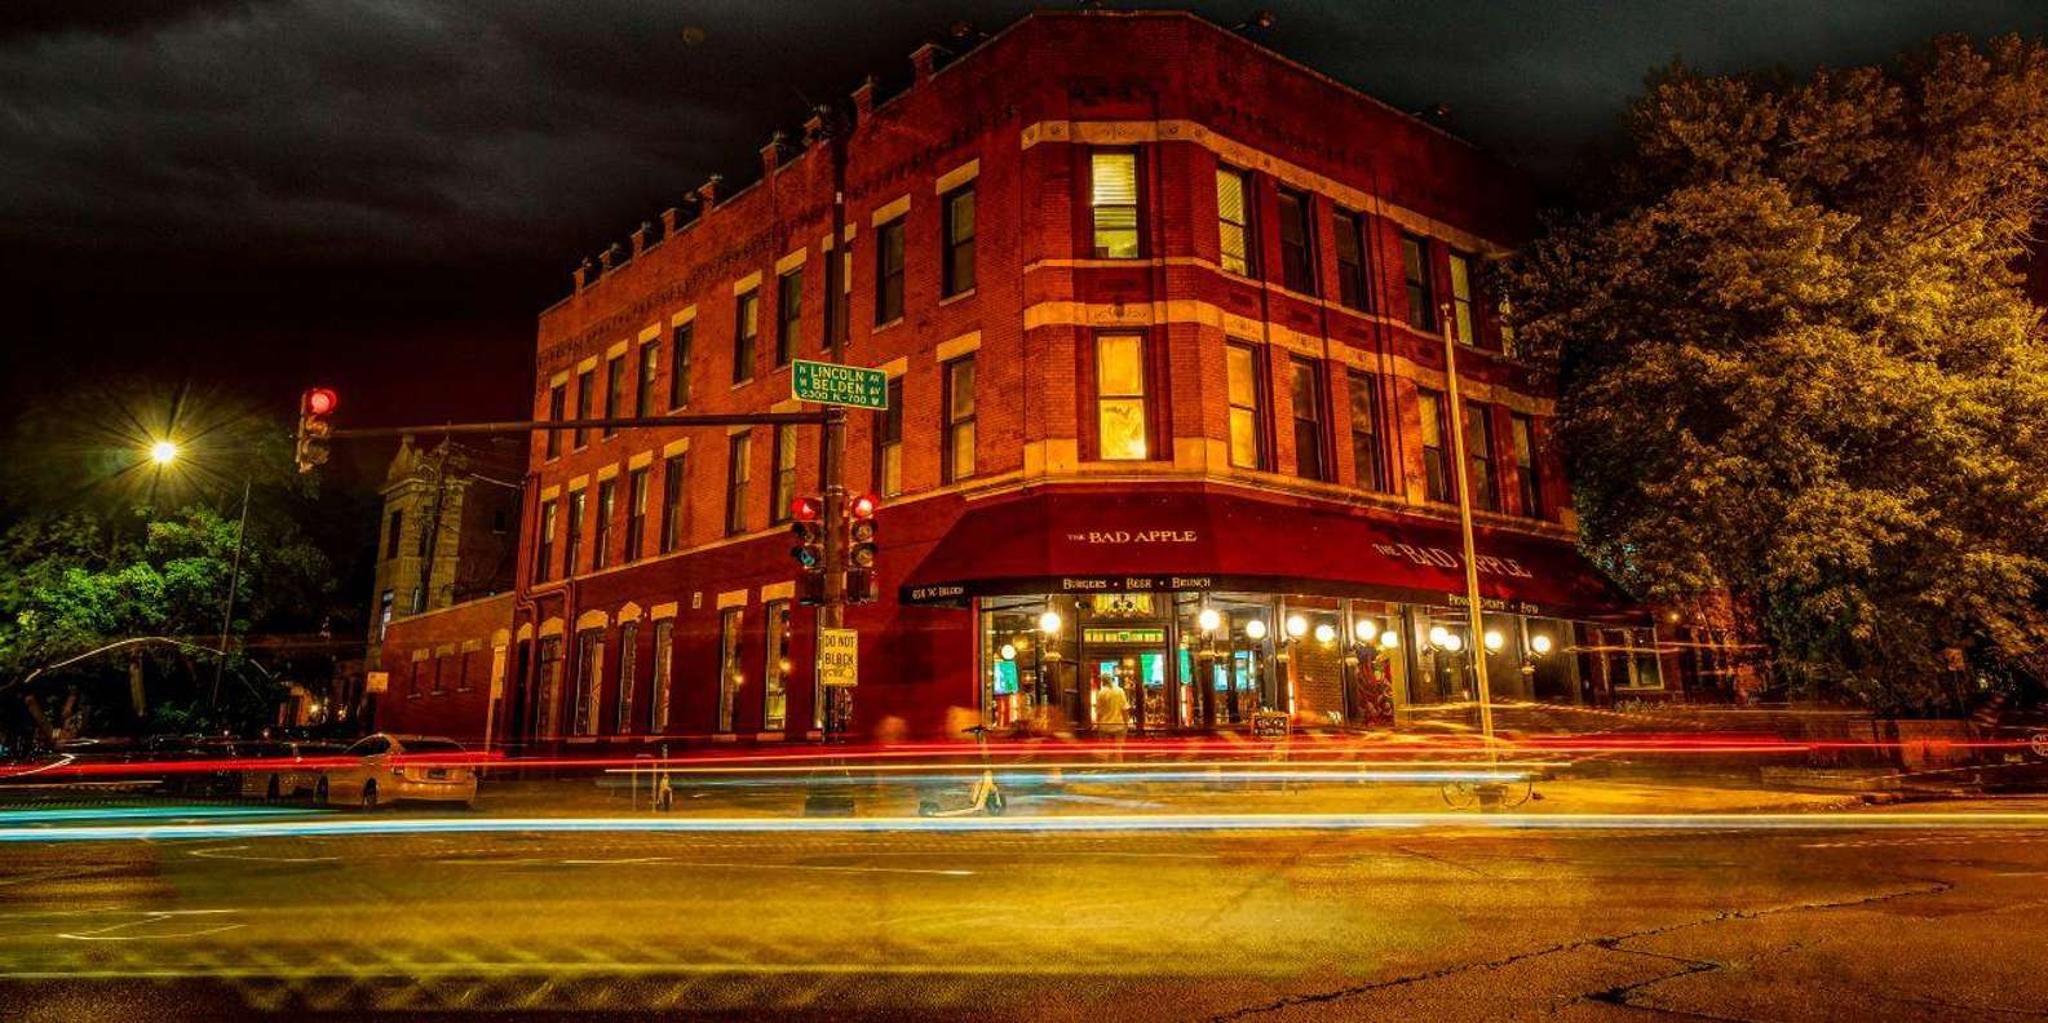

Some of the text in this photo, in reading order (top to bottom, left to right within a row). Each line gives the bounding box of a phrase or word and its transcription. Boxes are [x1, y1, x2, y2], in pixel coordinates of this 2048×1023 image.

[811, 366, 864, 382] LINCOLN
[813, 378, 864, 395] BELDEN
[801, 389, 828, 400] 2300
[1088, 531, 1131, 544] BAD
[1134, 530, 1197, 542] APPLE
[1396, 543, 1458, 568] BAD
[1458, 551, 1533, 578] PPLE
[825, 634, 854, 648] DO NOT
[825, 652, 854, 665] BLOCK
